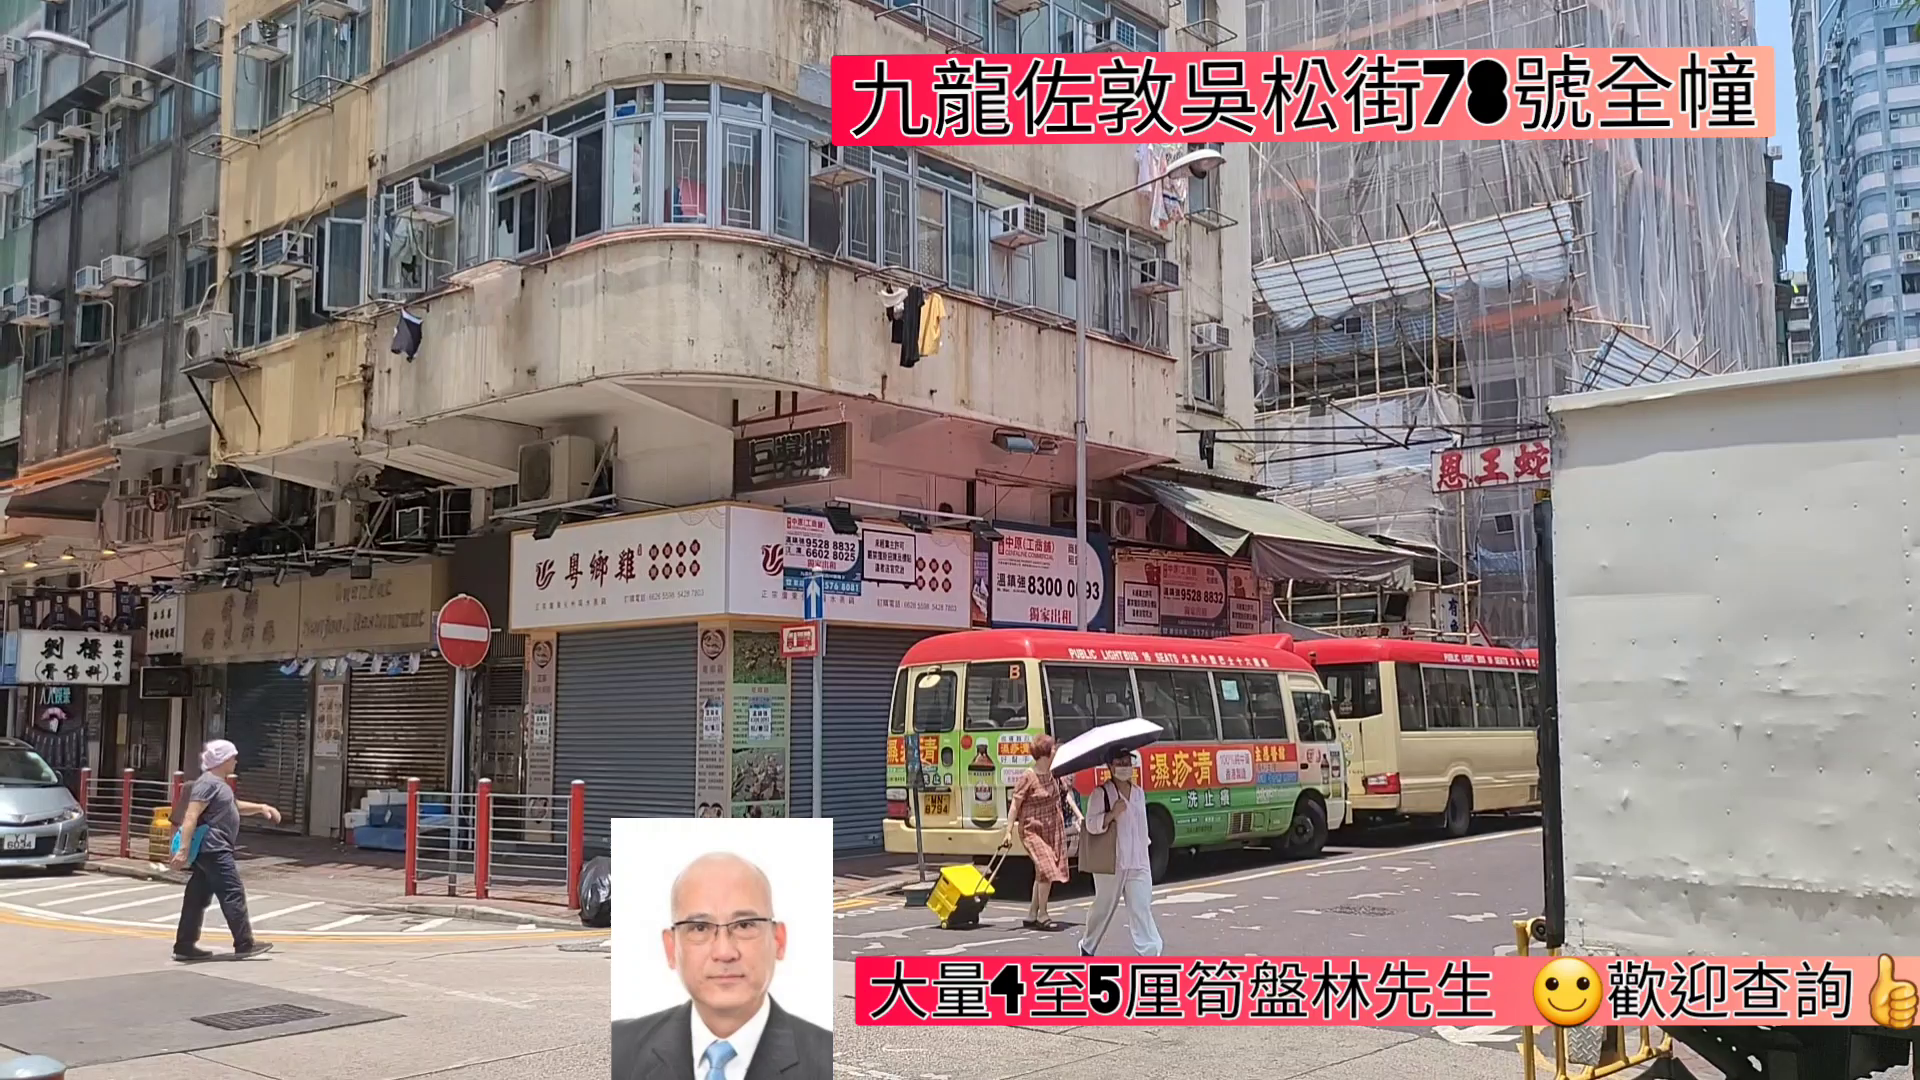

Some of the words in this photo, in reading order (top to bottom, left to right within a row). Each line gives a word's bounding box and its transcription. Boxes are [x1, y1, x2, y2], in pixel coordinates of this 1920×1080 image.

[805, 538, 829, 549] 9528
[832, 541, 856, 552] 8832
[805, 548, 829, 559] 6602
[832, 551, 856, 562] 8025
[1028, 575, 1063, 597] 8300
[1067, 579, 1100, 600] 093
[1181, 588, 1201, 602] 9528
[1203, 591, 1223, 604] 8832
[1068, 647, 1097, 660] PUBLIC
[1156, 653, 1179, 664] SEATS
[1009, 665, 1020, 680] B
[925, 804, 948, 815] 8794
